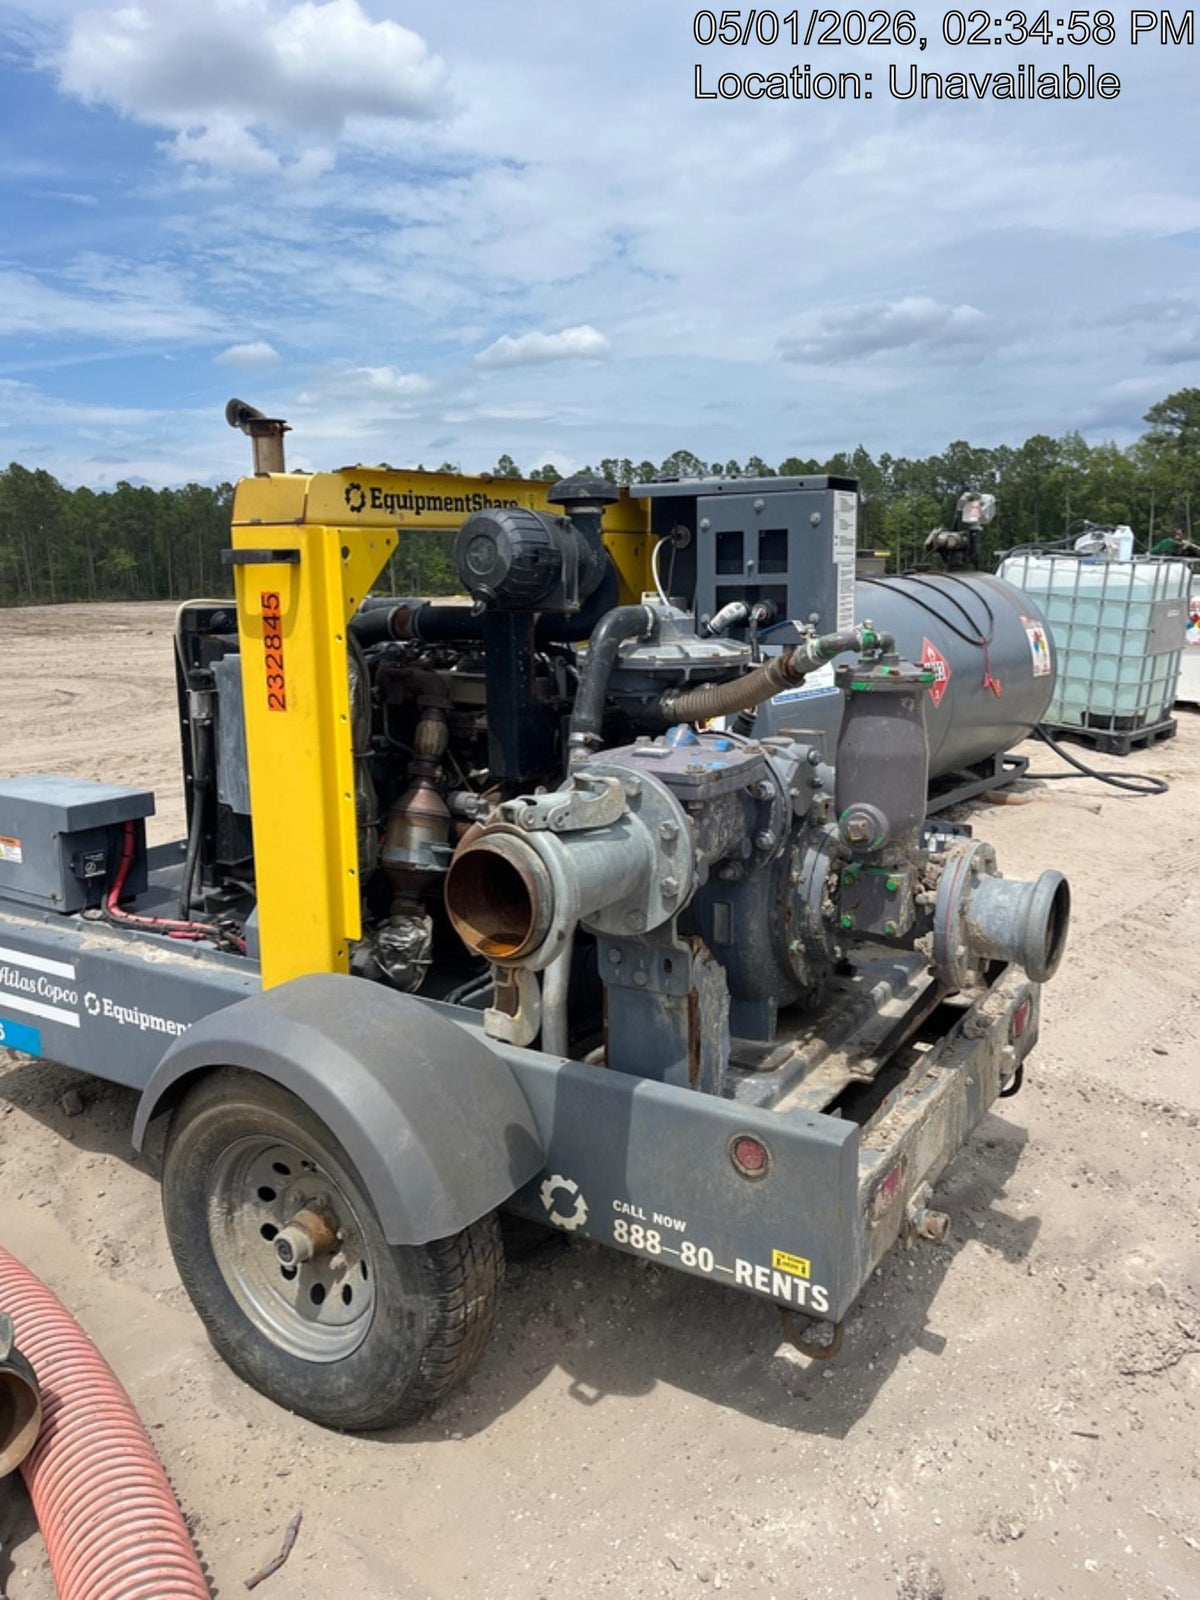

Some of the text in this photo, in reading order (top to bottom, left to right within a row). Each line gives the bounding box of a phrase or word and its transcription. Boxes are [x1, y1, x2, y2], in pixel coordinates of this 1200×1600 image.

[261, 593, 286, 710] 232845
[0, 966, 78, 1005] Atlas Copco
[102, 998, 192, 1037] Equipmen
[612, 1200, 687, 1233] CALL NOW
